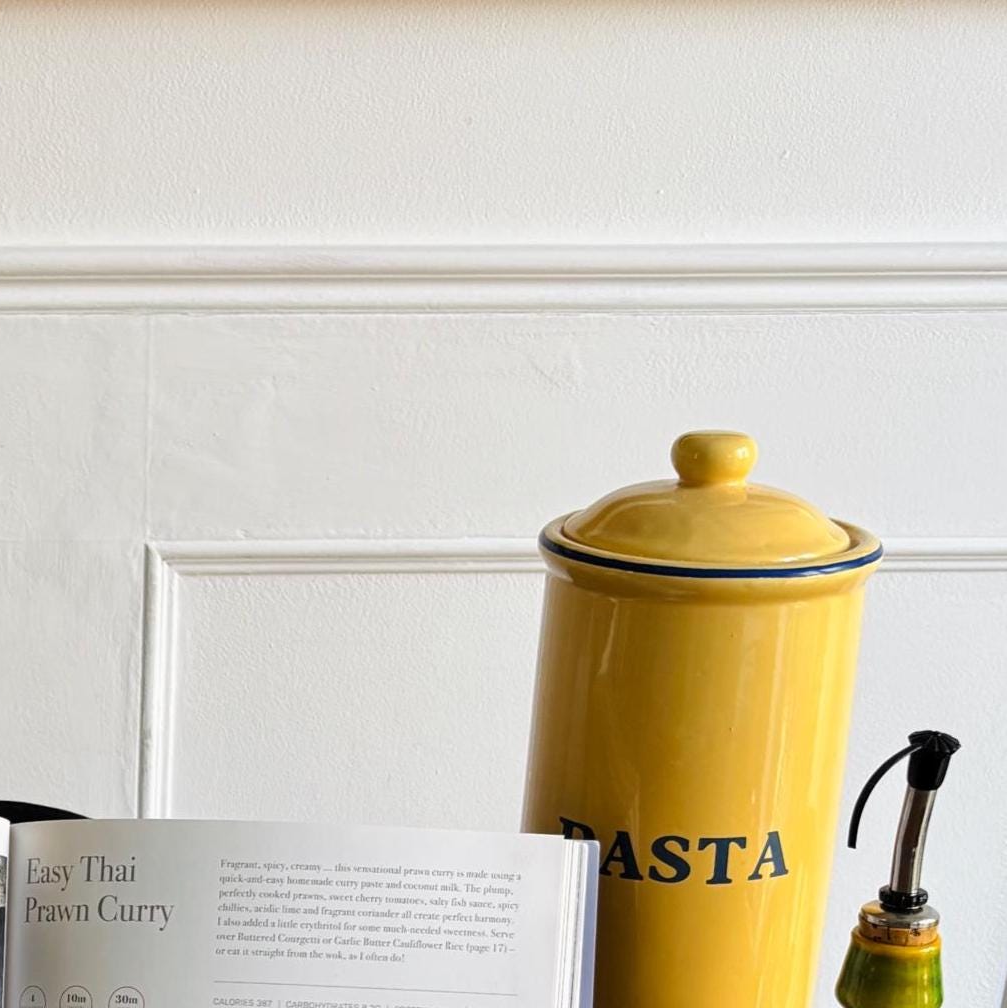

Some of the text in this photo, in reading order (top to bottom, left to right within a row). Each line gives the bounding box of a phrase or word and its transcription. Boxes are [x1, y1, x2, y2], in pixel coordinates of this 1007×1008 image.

[27, 856, 136, 892] Easy Thai
[220, 859, 261, 873] Fragrant,
[262, 861, 289, 874] spicy,
[289, 864, 321, 875] creamy
[334, 863, 351, 873] this
[353, 864, 401, 875] sensational
[404, 868, 430, 879] prawn
[432, 869, 454, 880] curry
[466, 868, 488, 878] made
[491, 869, 514, 882] using
[219, 874, 284, 888] quick-and-easy
[335, 881, 359, 891] curry
[360, 879, 384, 892] paste
[385, 880, 401, 890] and
[403, 881, 438, 891] coconut
[462, 883, 481, 893] The
[482, 884, 513, 897] plump,
[218, 888, 519, 912] perfectly cooked prawns, sweet cherry tomatoes, salty fish sauce, spicy
[24, 894, 175, 932] Prawn Curry
[217, 903, 252, 916] chillies,
[254, 904, 280, 914] acidic
[281, 905, 301, 915] lime
[303, 906, 319, 916] and
[320, 907, 355, 920] fragrant
[356, 908, 400, 919] coriander
[401, 910, 411, 919] all
[414, 910, 439, 920] create
[443, 911, 472, 924] perfect
[67, 994, 86, 1003] 10m
[115, 994, 138, 1004] 30m
[212, 997, 254, 1007] CALORIES
